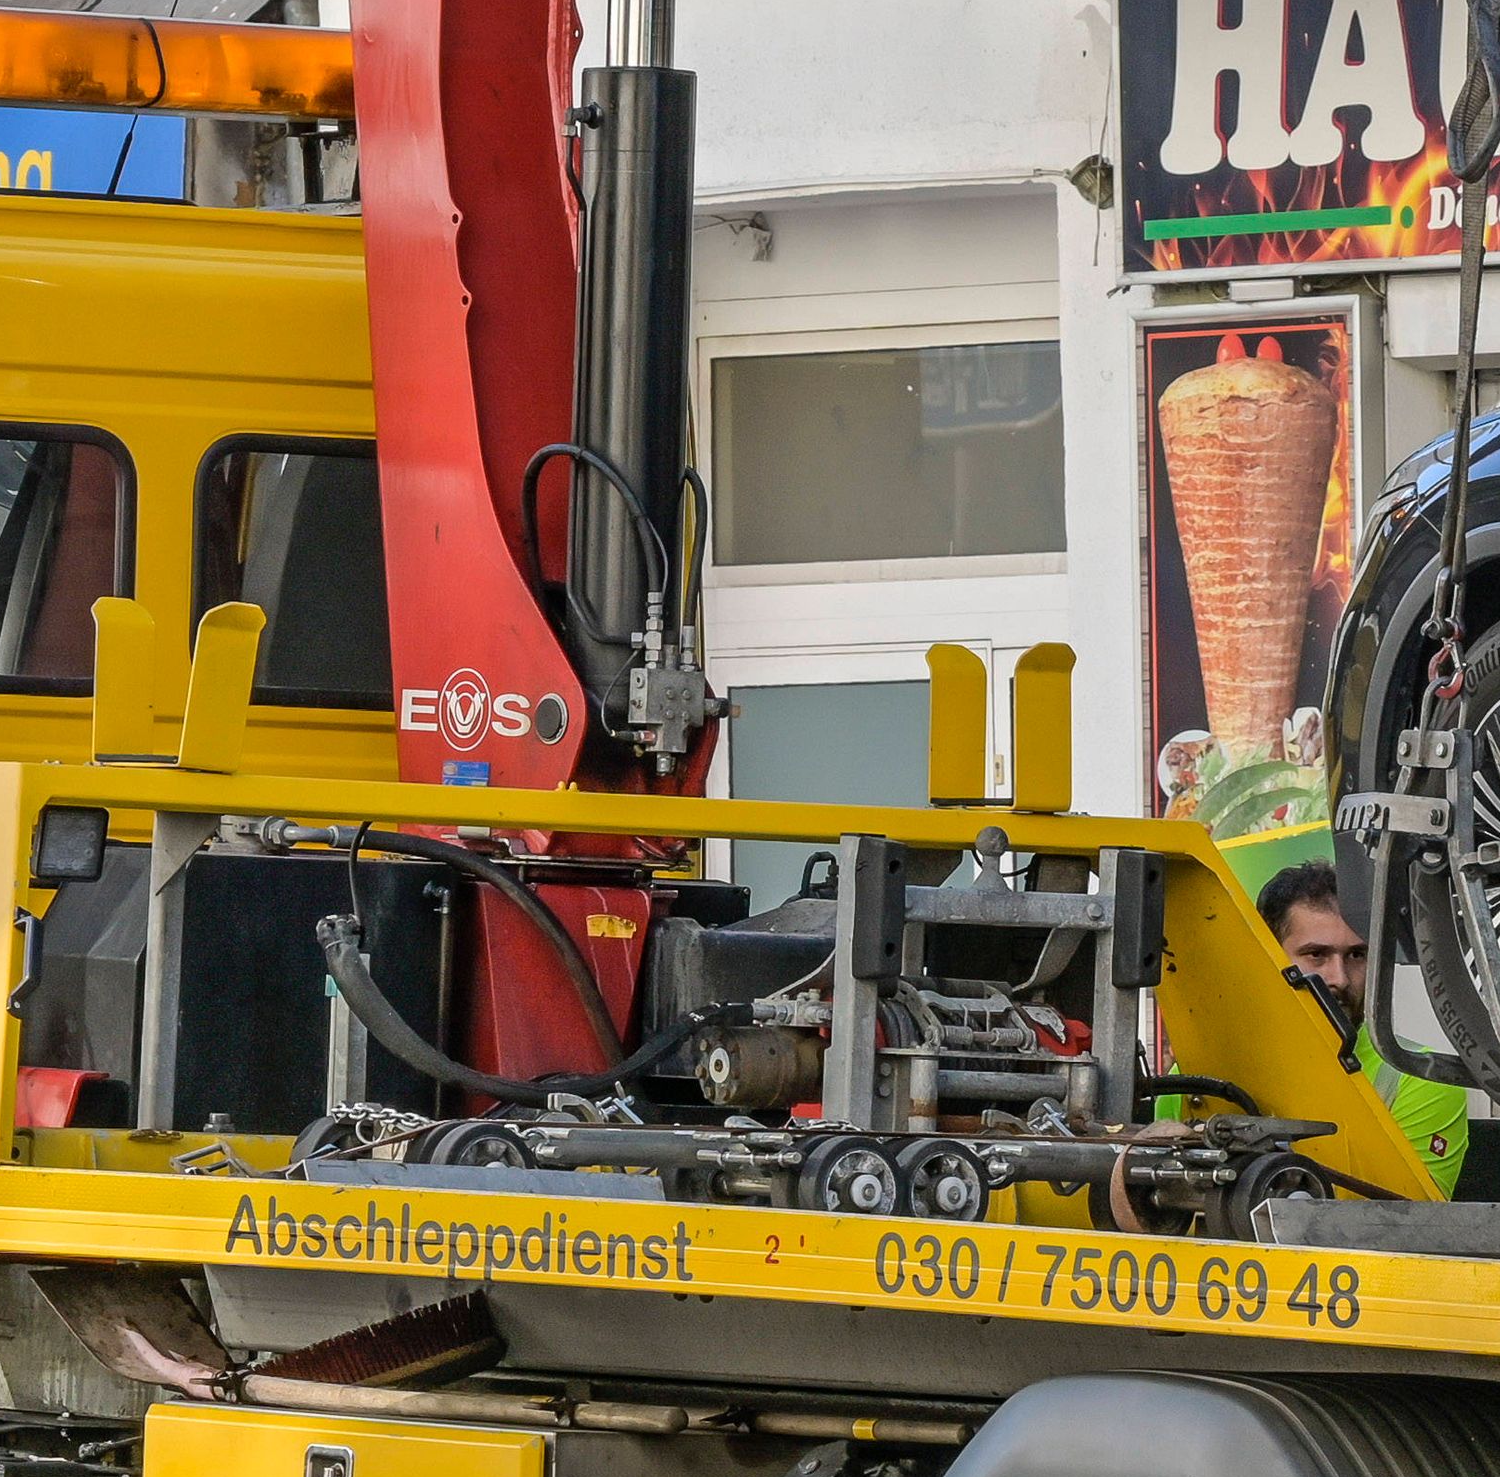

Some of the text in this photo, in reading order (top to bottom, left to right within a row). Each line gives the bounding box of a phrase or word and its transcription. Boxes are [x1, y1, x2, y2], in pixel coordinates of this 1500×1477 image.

[225, 1194, 694, 1284] Abschleppdienst
[875, 1232, 982, 1300] 030
[1036, 1244, 1178, 1316] 7500
[1197, 1258, 1267, 1321] 69
[1287, 1263, 1361, 1328] 48
